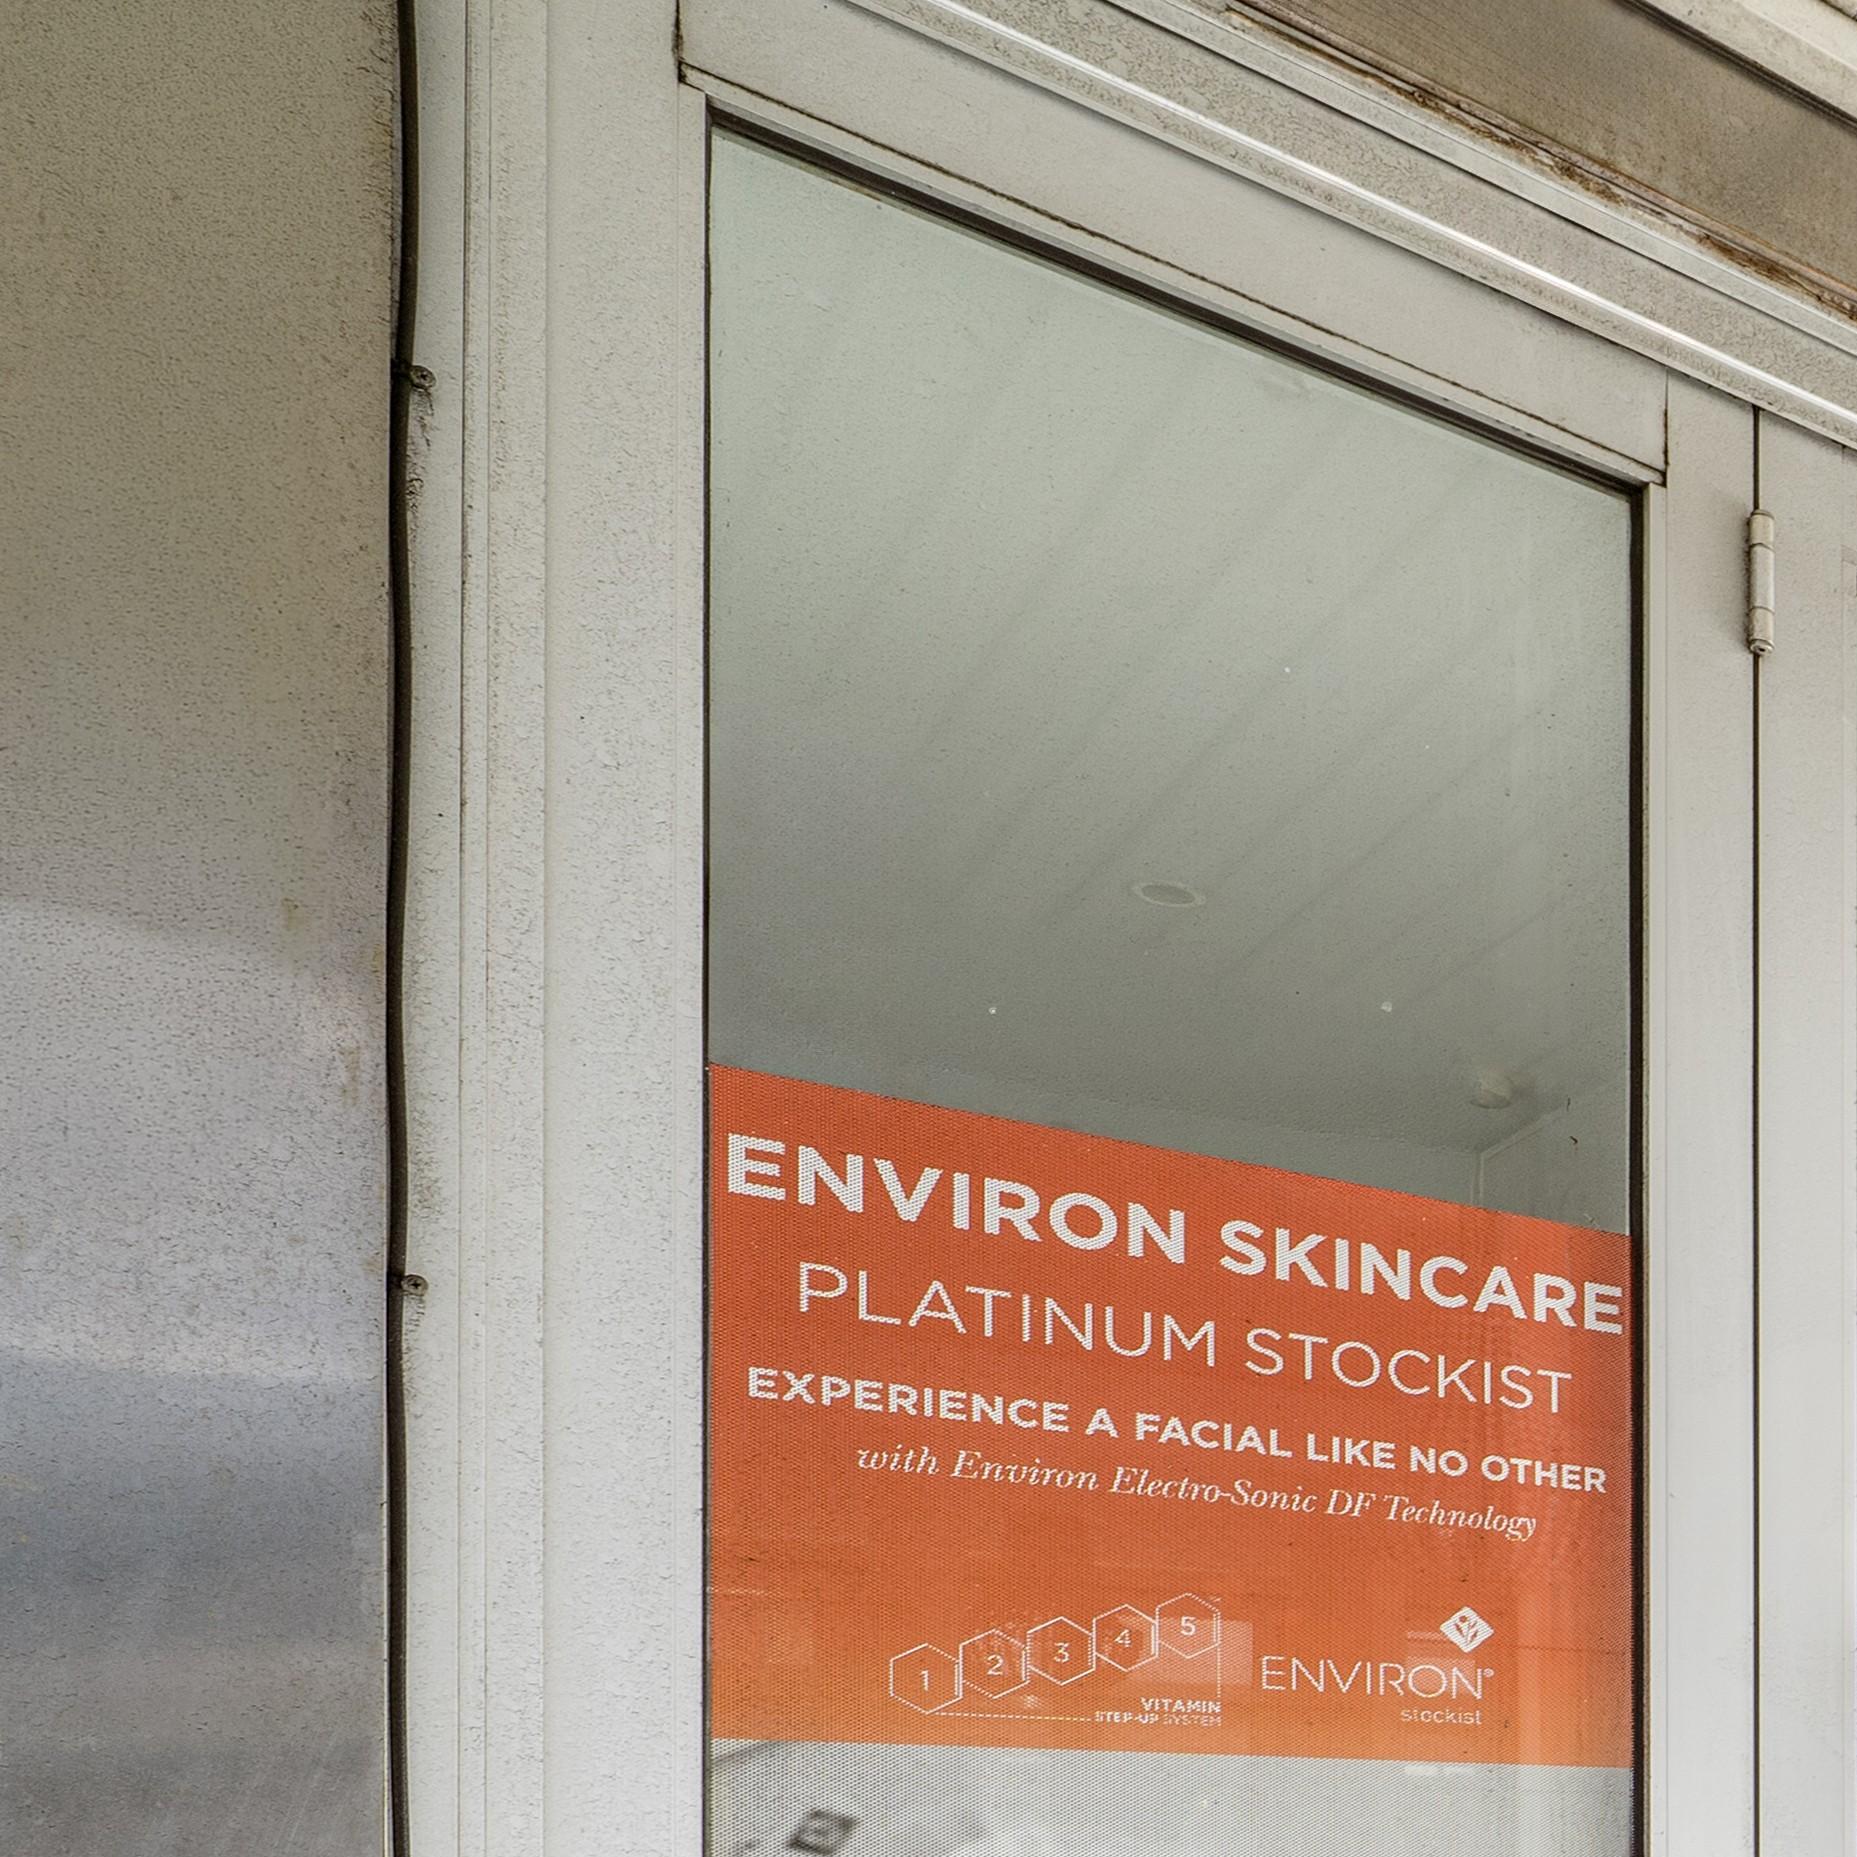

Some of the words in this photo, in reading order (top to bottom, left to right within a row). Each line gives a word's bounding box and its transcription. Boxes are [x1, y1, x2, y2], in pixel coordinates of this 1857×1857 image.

[727, 1133, 1185, 1264] ENVIRON
[1219, 1220, 1623, 1335] SKINCARE
[799, 1261, 1215, 1367] PLATINUM
[1246, 1327, 1572, 1414] STOCKIST
[747, 1366, 1071, 1433] EXPERIENCE
[1086, 1408, 1119, 1438] A
[1135, 1412, 1293, 1459] FACIAL
[1306, 1433, 1396, 1471] LIKE
[1410, 1446, 1469, 1478] NO
[1480, 1455, 1607, 1494] OTHER
[856, 1444, 940, 1476] with
[950, 1449, 1100, 1492] Environ
[1108, 1466, 1318, 1514] Electro-Sonic
[1325, 1488, 1377, 1519] DF
[1385, 1493, 1537, 1542] Technology
[1180, 1616, 1196, 1636] 5
[1114, 1629, 1131, 1648] 4
[1053, 1642, 1069, 1662] 3
[987, 1654, 1004, 1676] 2
[921, 1670, 930, 1691] 1
[1140, 1697, 1221, 1714] VITAMIN
[1095, 1711, 1159, 1725] STEP-UP
[1162, 1713, 1221, 1727] SYSTEM
[1400, 1709, 1482, 1725] stockist
